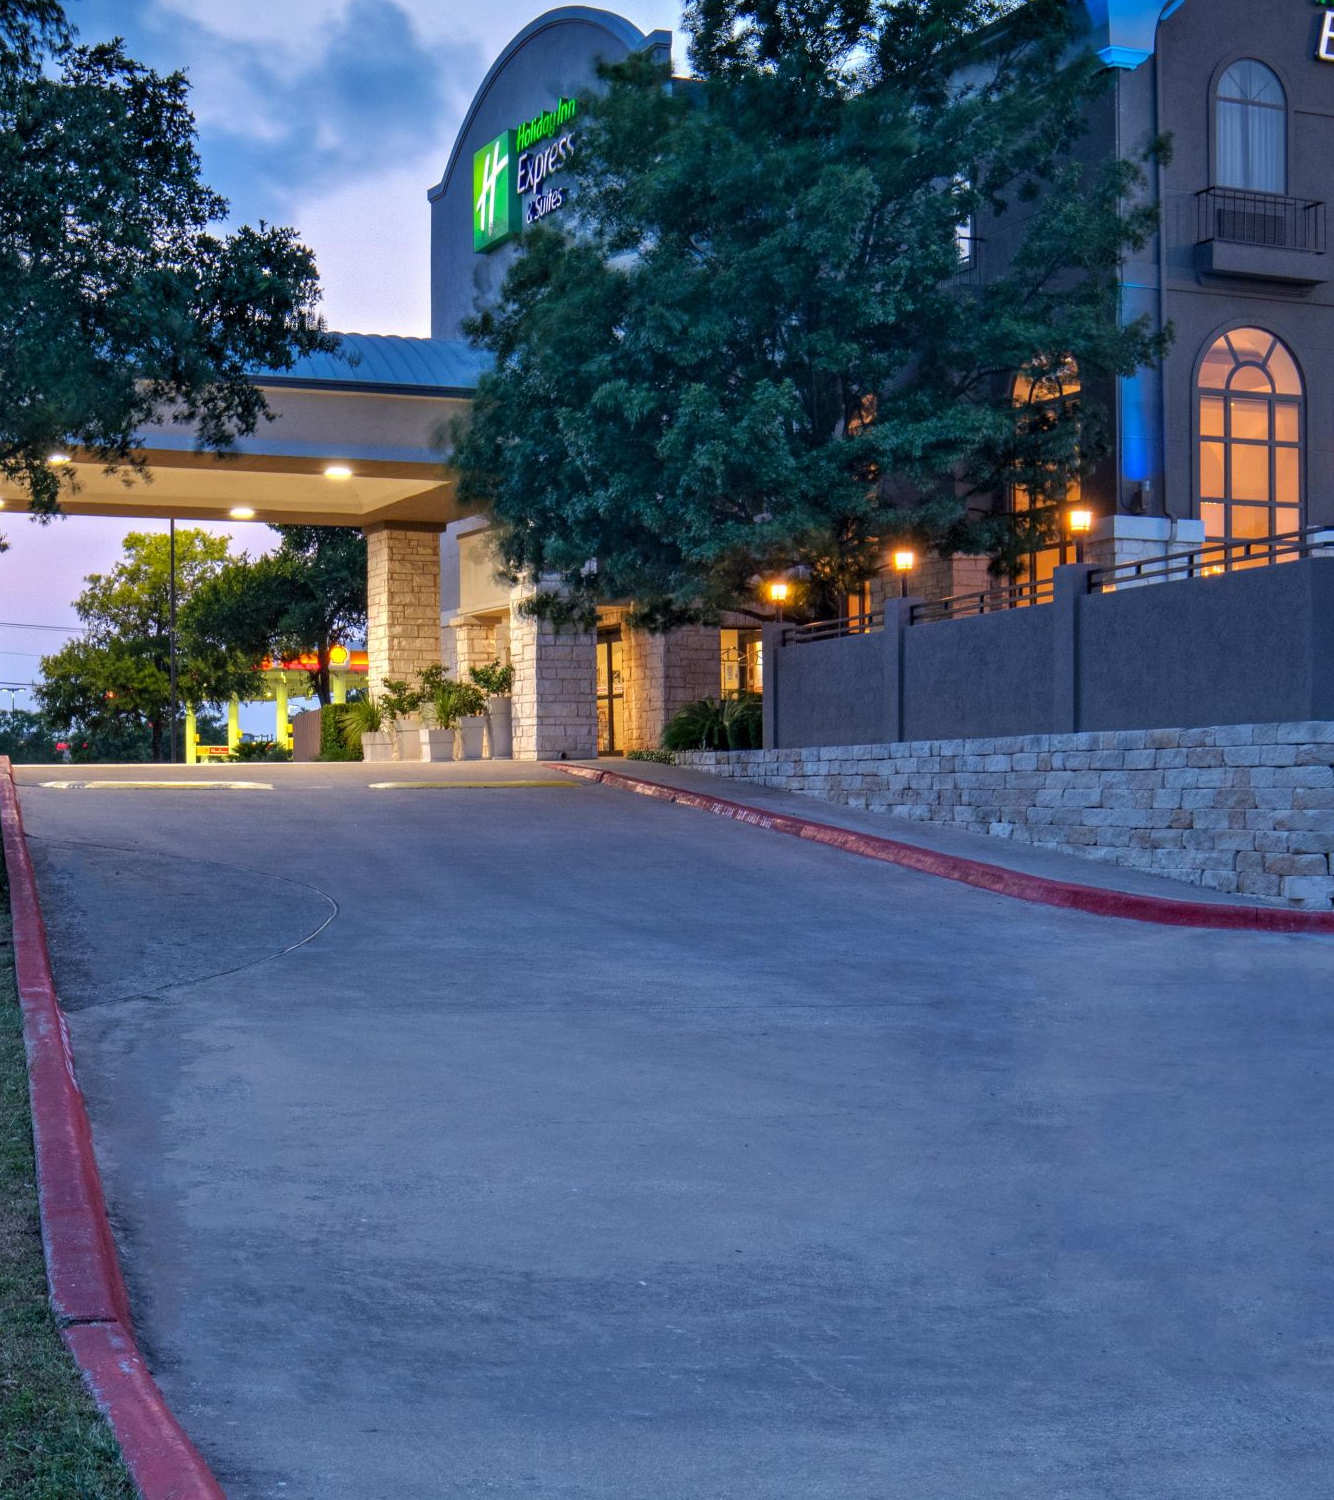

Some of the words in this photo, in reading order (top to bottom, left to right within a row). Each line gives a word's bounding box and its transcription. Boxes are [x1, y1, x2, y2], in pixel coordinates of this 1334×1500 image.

[517, 109, 557, 152] Holiday
[556, 97, 576, 126] Inn
[517, 131, 576, 195] Express
[534, 187, 563, 221] Suites
